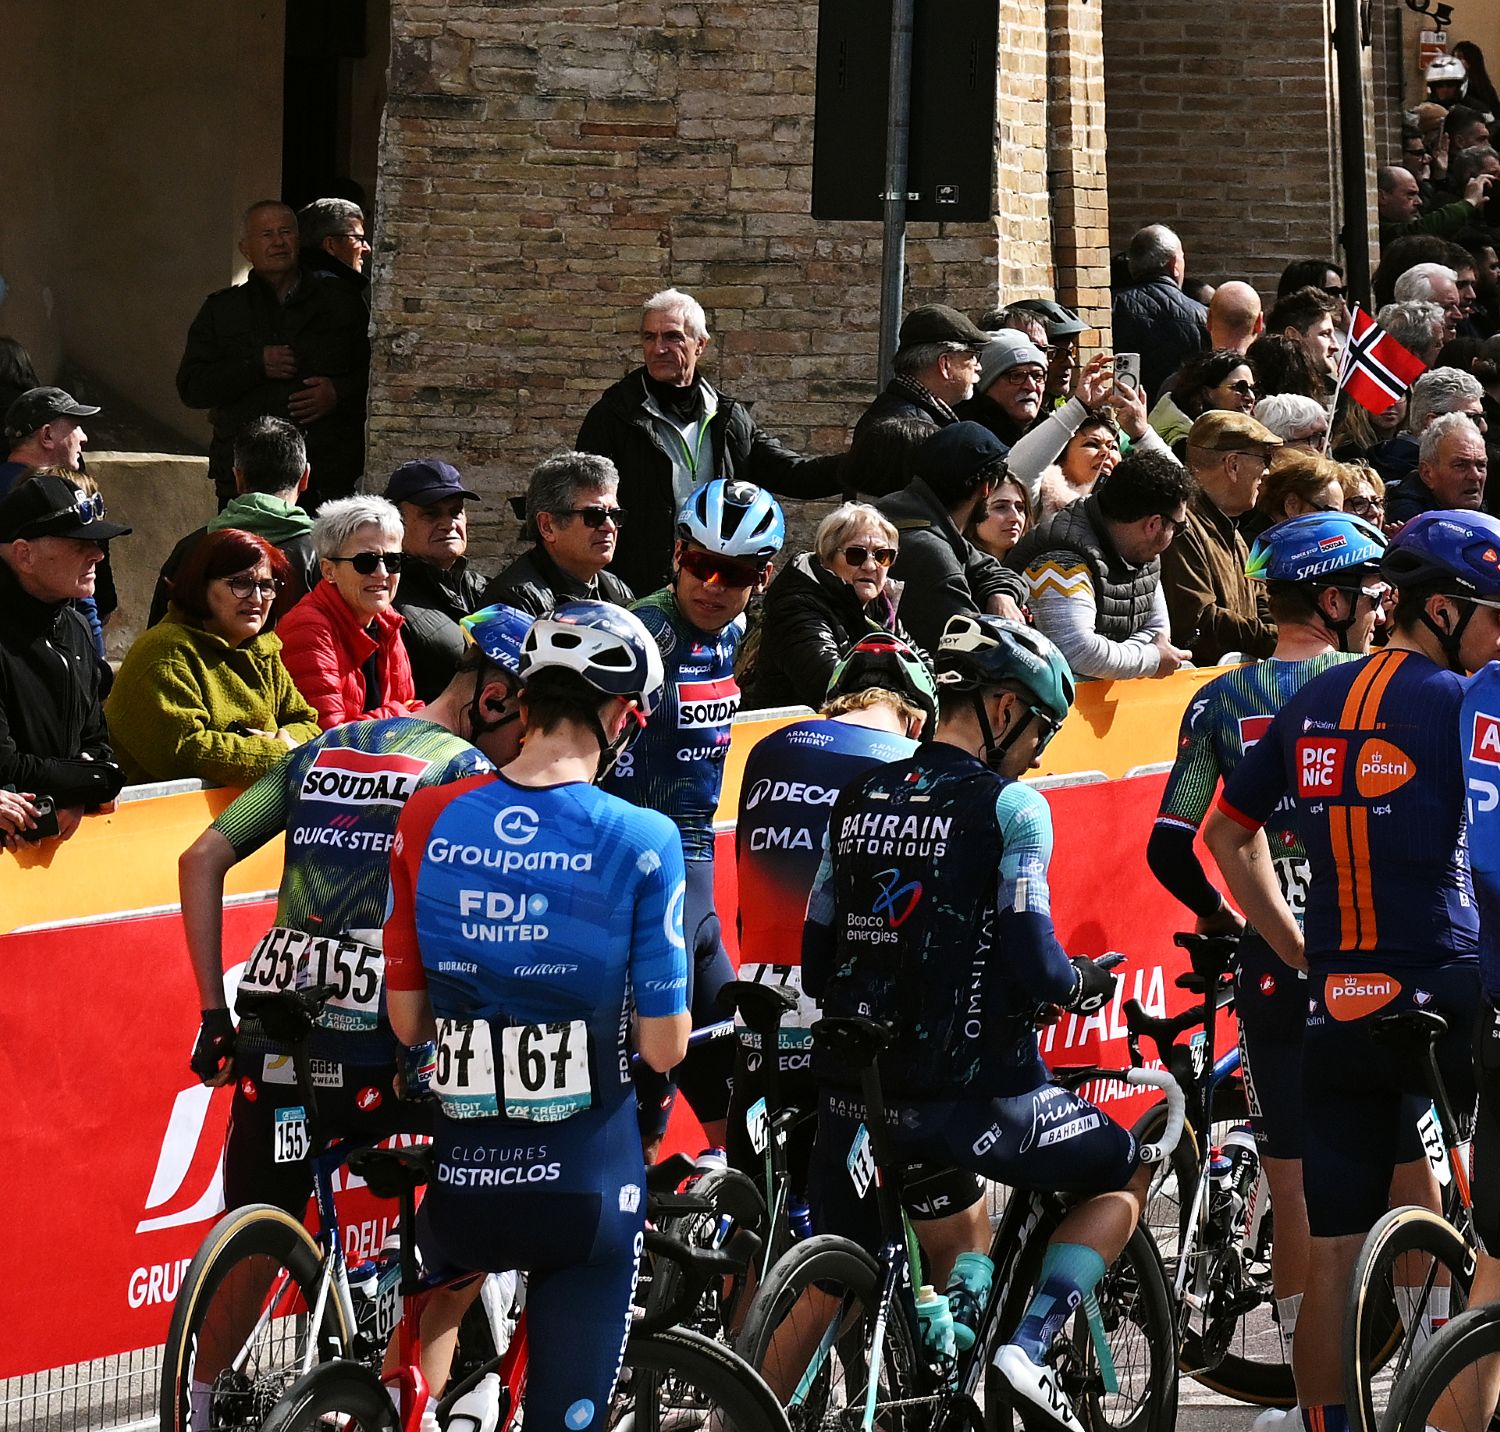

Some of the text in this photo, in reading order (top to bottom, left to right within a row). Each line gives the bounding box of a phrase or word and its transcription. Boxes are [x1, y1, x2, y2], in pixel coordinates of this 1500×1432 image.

[1296, 546, 1378, 580] SPECIALIZED
[1302, 746, 1336, 769] PIC
[1361, 759, 1408, 779] postnl
[303, 768, 411, 801] SOUDAL
[841, 813, 952, 842] BAHRAIN
[428, 838, 593, 875] Groupama
[837, 838, 948, 858] VICTORIOUS
[847, 912, 883, 928] Bapco
[462, 923, 550, 942] UNITED
[847, 925, 899, 945] energies
[1332, 981, 1392, 1001] postnl
[452, 1144, 548, 1162] CLÔTURES
[1418, 1120, 1444, 1171] 172
[438, 1162, 562, 1187] DISTRICLOS
